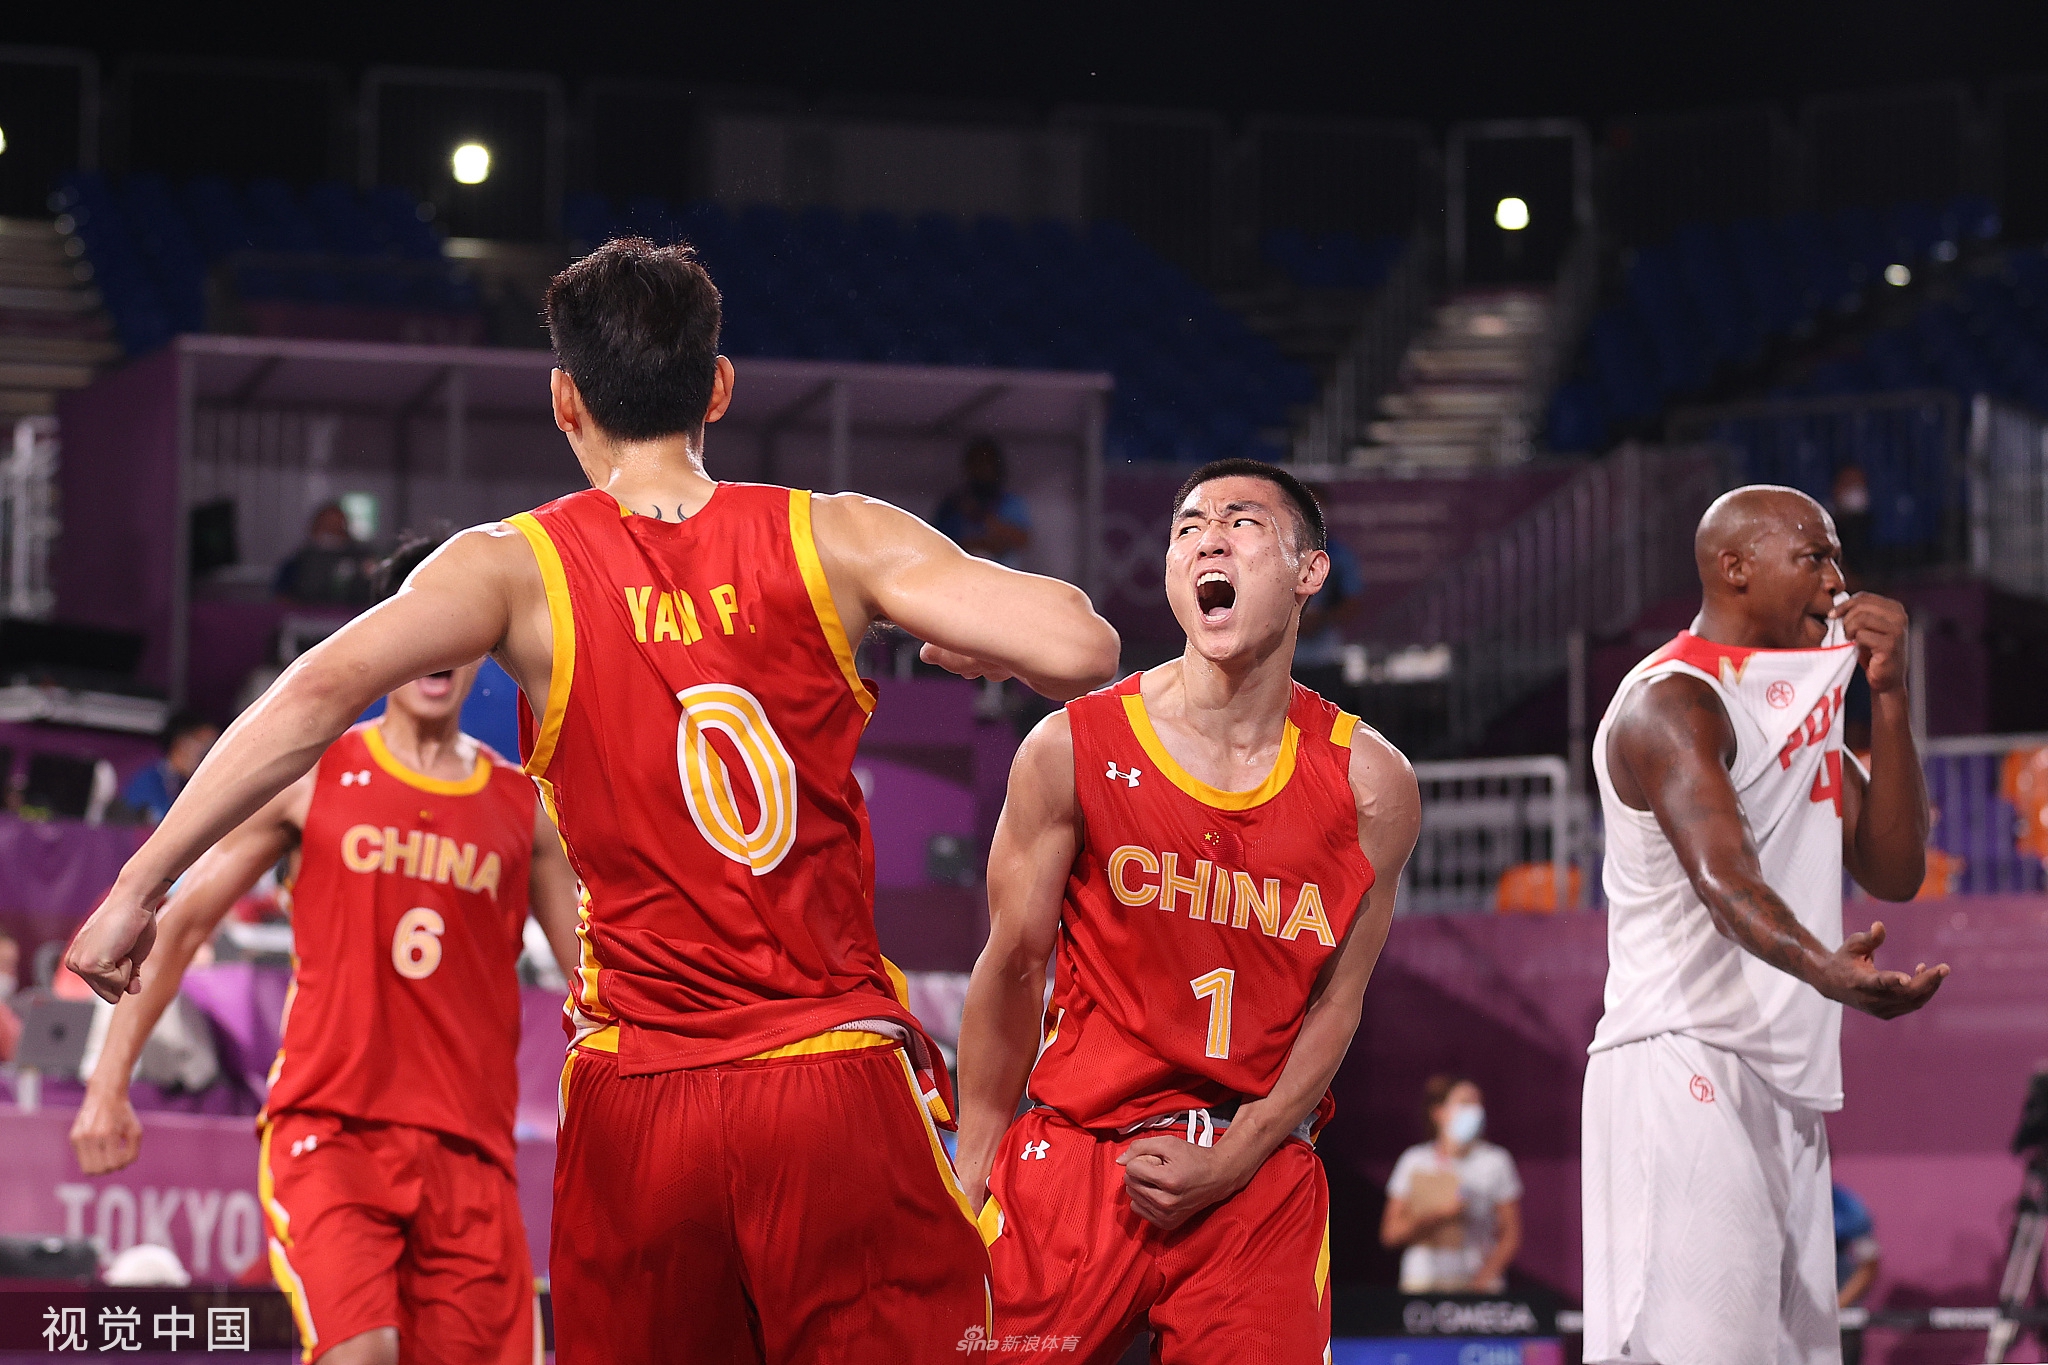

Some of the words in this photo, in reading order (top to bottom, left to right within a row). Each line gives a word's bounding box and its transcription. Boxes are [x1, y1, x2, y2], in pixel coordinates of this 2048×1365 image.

[624, 586, 703, 646] YAN
[676, 683, 798, 876] 0
[341, 824, 501, 903] CHINA
[1108, 845, 1337, 948] CHINA
[392, 907, 446, 980] 6
[1190, 967, 1235, 1060] 1
[56, 1184, 261, 1276] TOKYO
